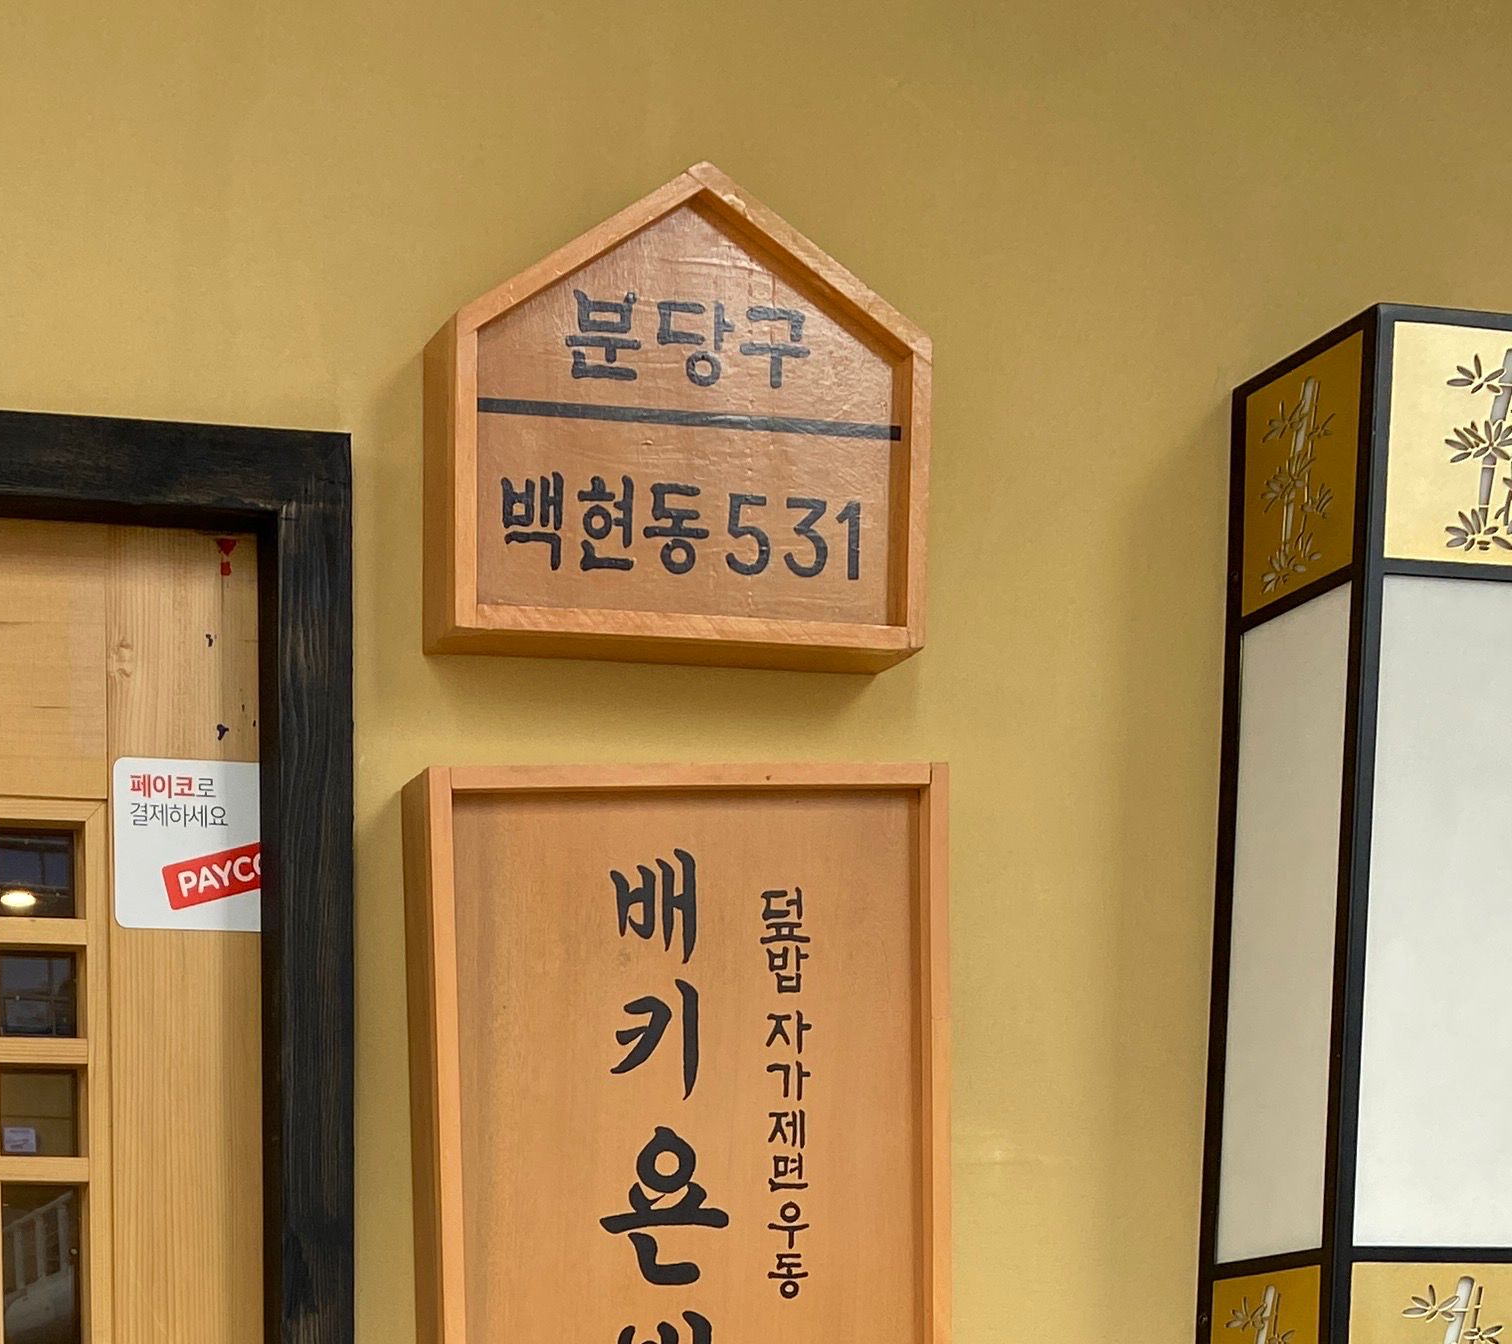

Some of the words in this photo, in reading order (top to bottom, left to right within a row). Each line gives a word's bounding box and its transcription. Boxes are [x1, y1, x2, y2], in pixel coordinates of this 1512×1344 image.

[565, 289, 811, 388] 분당구
[130, 774, 216, 798] 페이코로
[130, 802, 228, 828] 결제하세요
[760, 887, 811, 994] 덮밥
